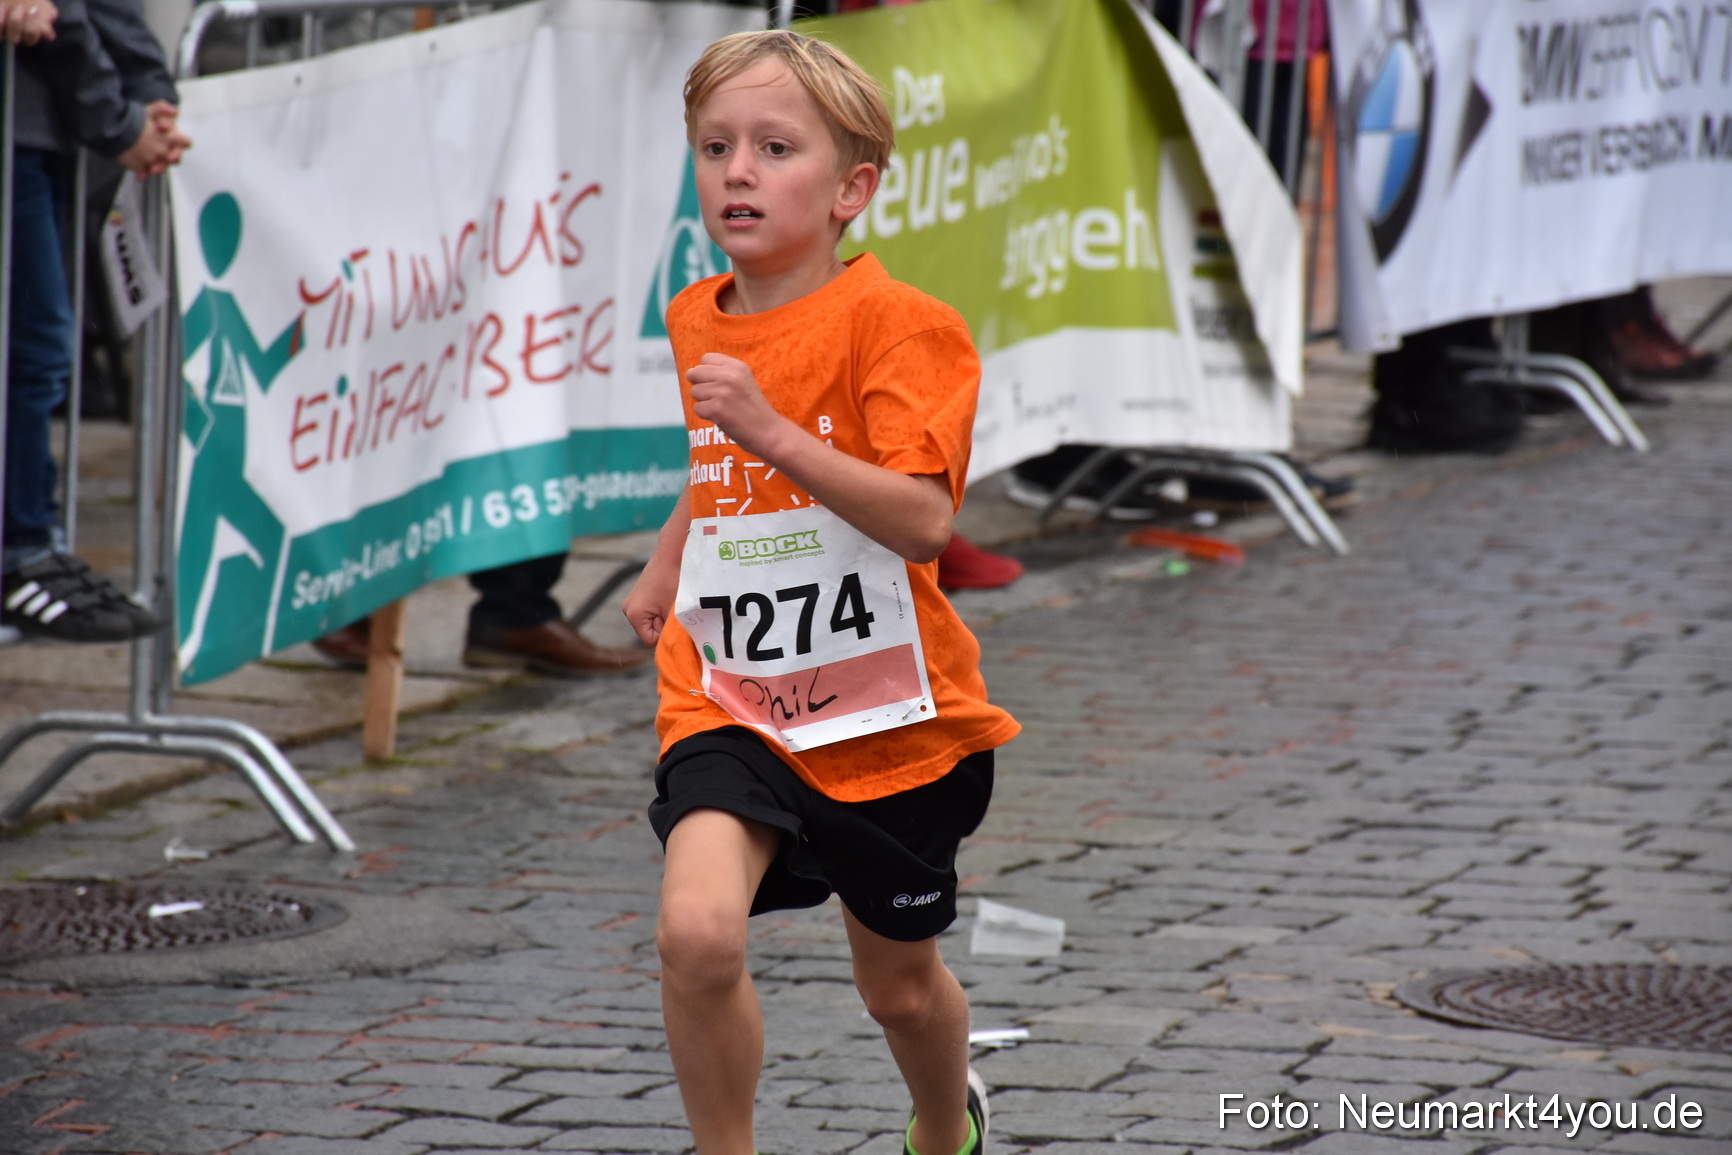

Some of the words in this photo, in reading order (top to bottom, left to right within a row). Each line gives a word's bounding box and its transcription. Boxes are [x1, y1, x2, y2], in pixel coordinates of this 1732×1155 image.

[893, 66, 946, 130] Der
[852, 138, 969, 241] eue
[482, 483, 540, 529] 63
[736, 529, 823, 560] BOCK
[774, 553, 794, 563] smart
[795, 549, 826, 558] concepts
[699, 572, 875, 662] 7274
[910, 890, 942, 907] JAKO
